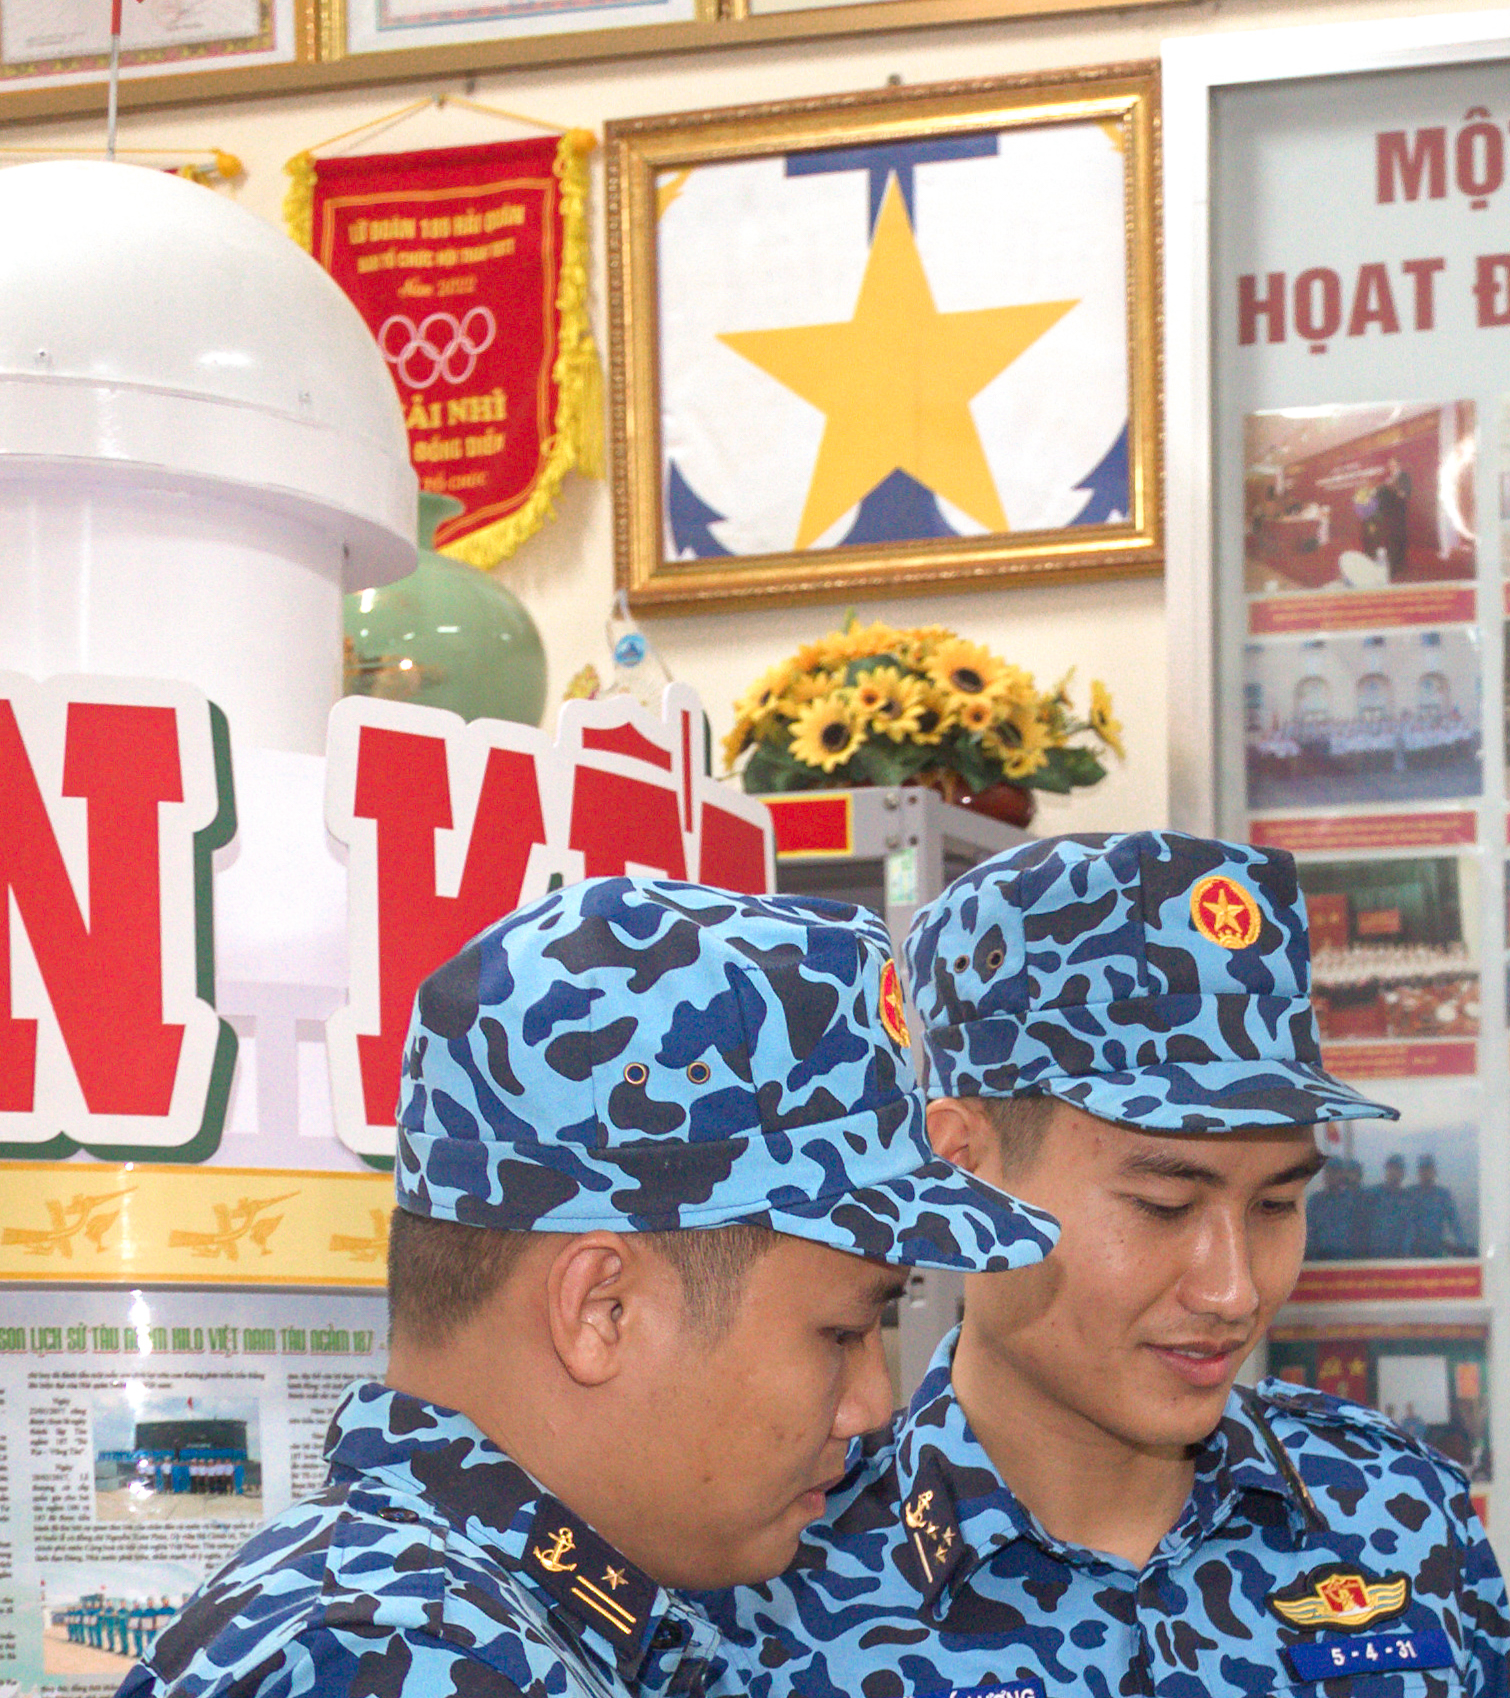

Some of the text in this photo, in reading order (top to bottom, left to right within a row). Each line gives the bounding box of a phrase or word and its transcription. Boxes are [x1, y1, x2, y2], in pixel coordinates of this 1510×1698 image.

[404, 393, 441, 430] ẢI
[1331, 1647, 1345, 1666] 5
[1366, 1642, 1378, 1661] 4
[1396, 1640, 1418, 1659] 31
